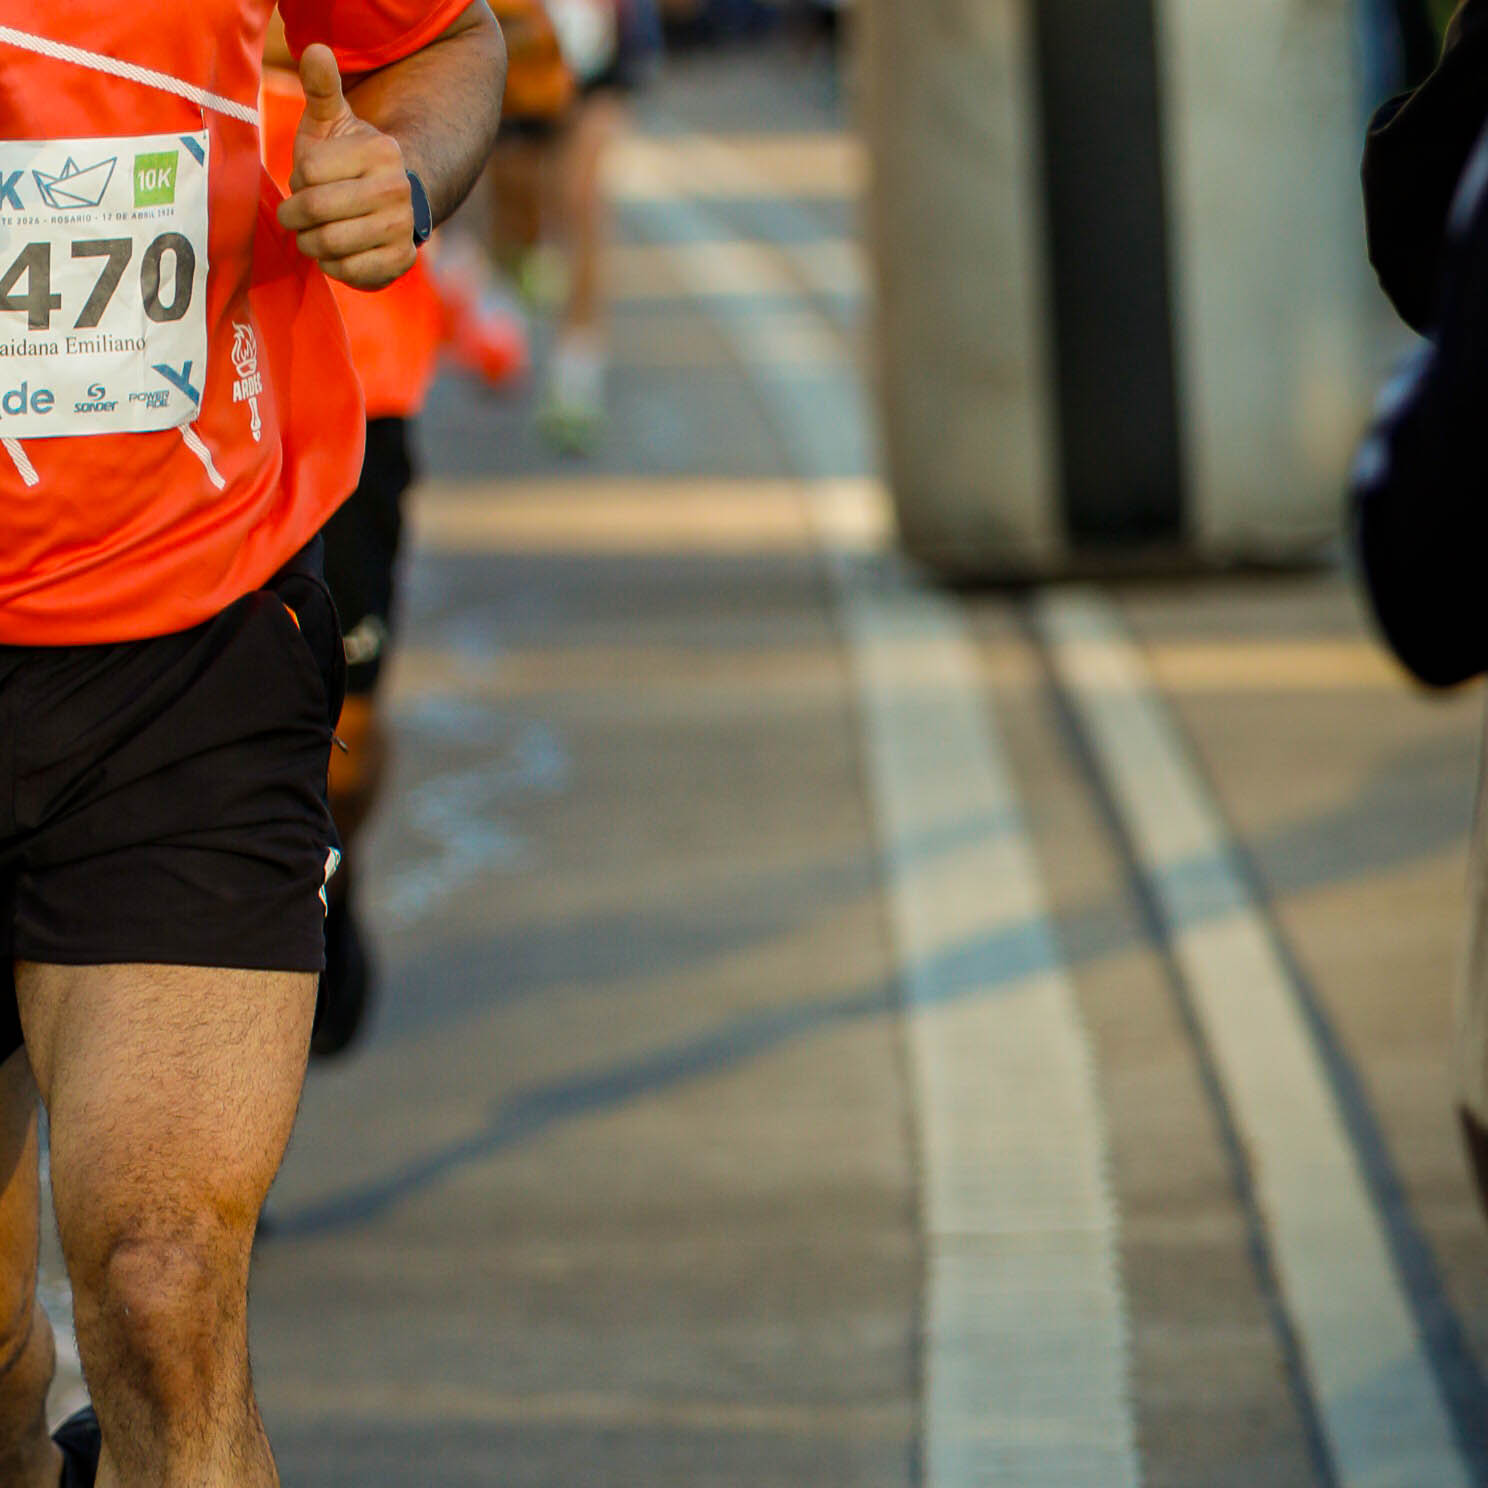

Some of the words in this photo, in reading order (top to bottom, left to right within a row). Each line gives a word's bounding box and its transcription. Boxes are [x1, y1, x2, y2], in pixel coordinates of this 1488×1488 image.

[137, 167, 173, 192] 10K
[50, 214, 93, 225] ROSARIO
[65, 333, 147, 356] Emiliano
[128, 390, 170, 402] POWER
